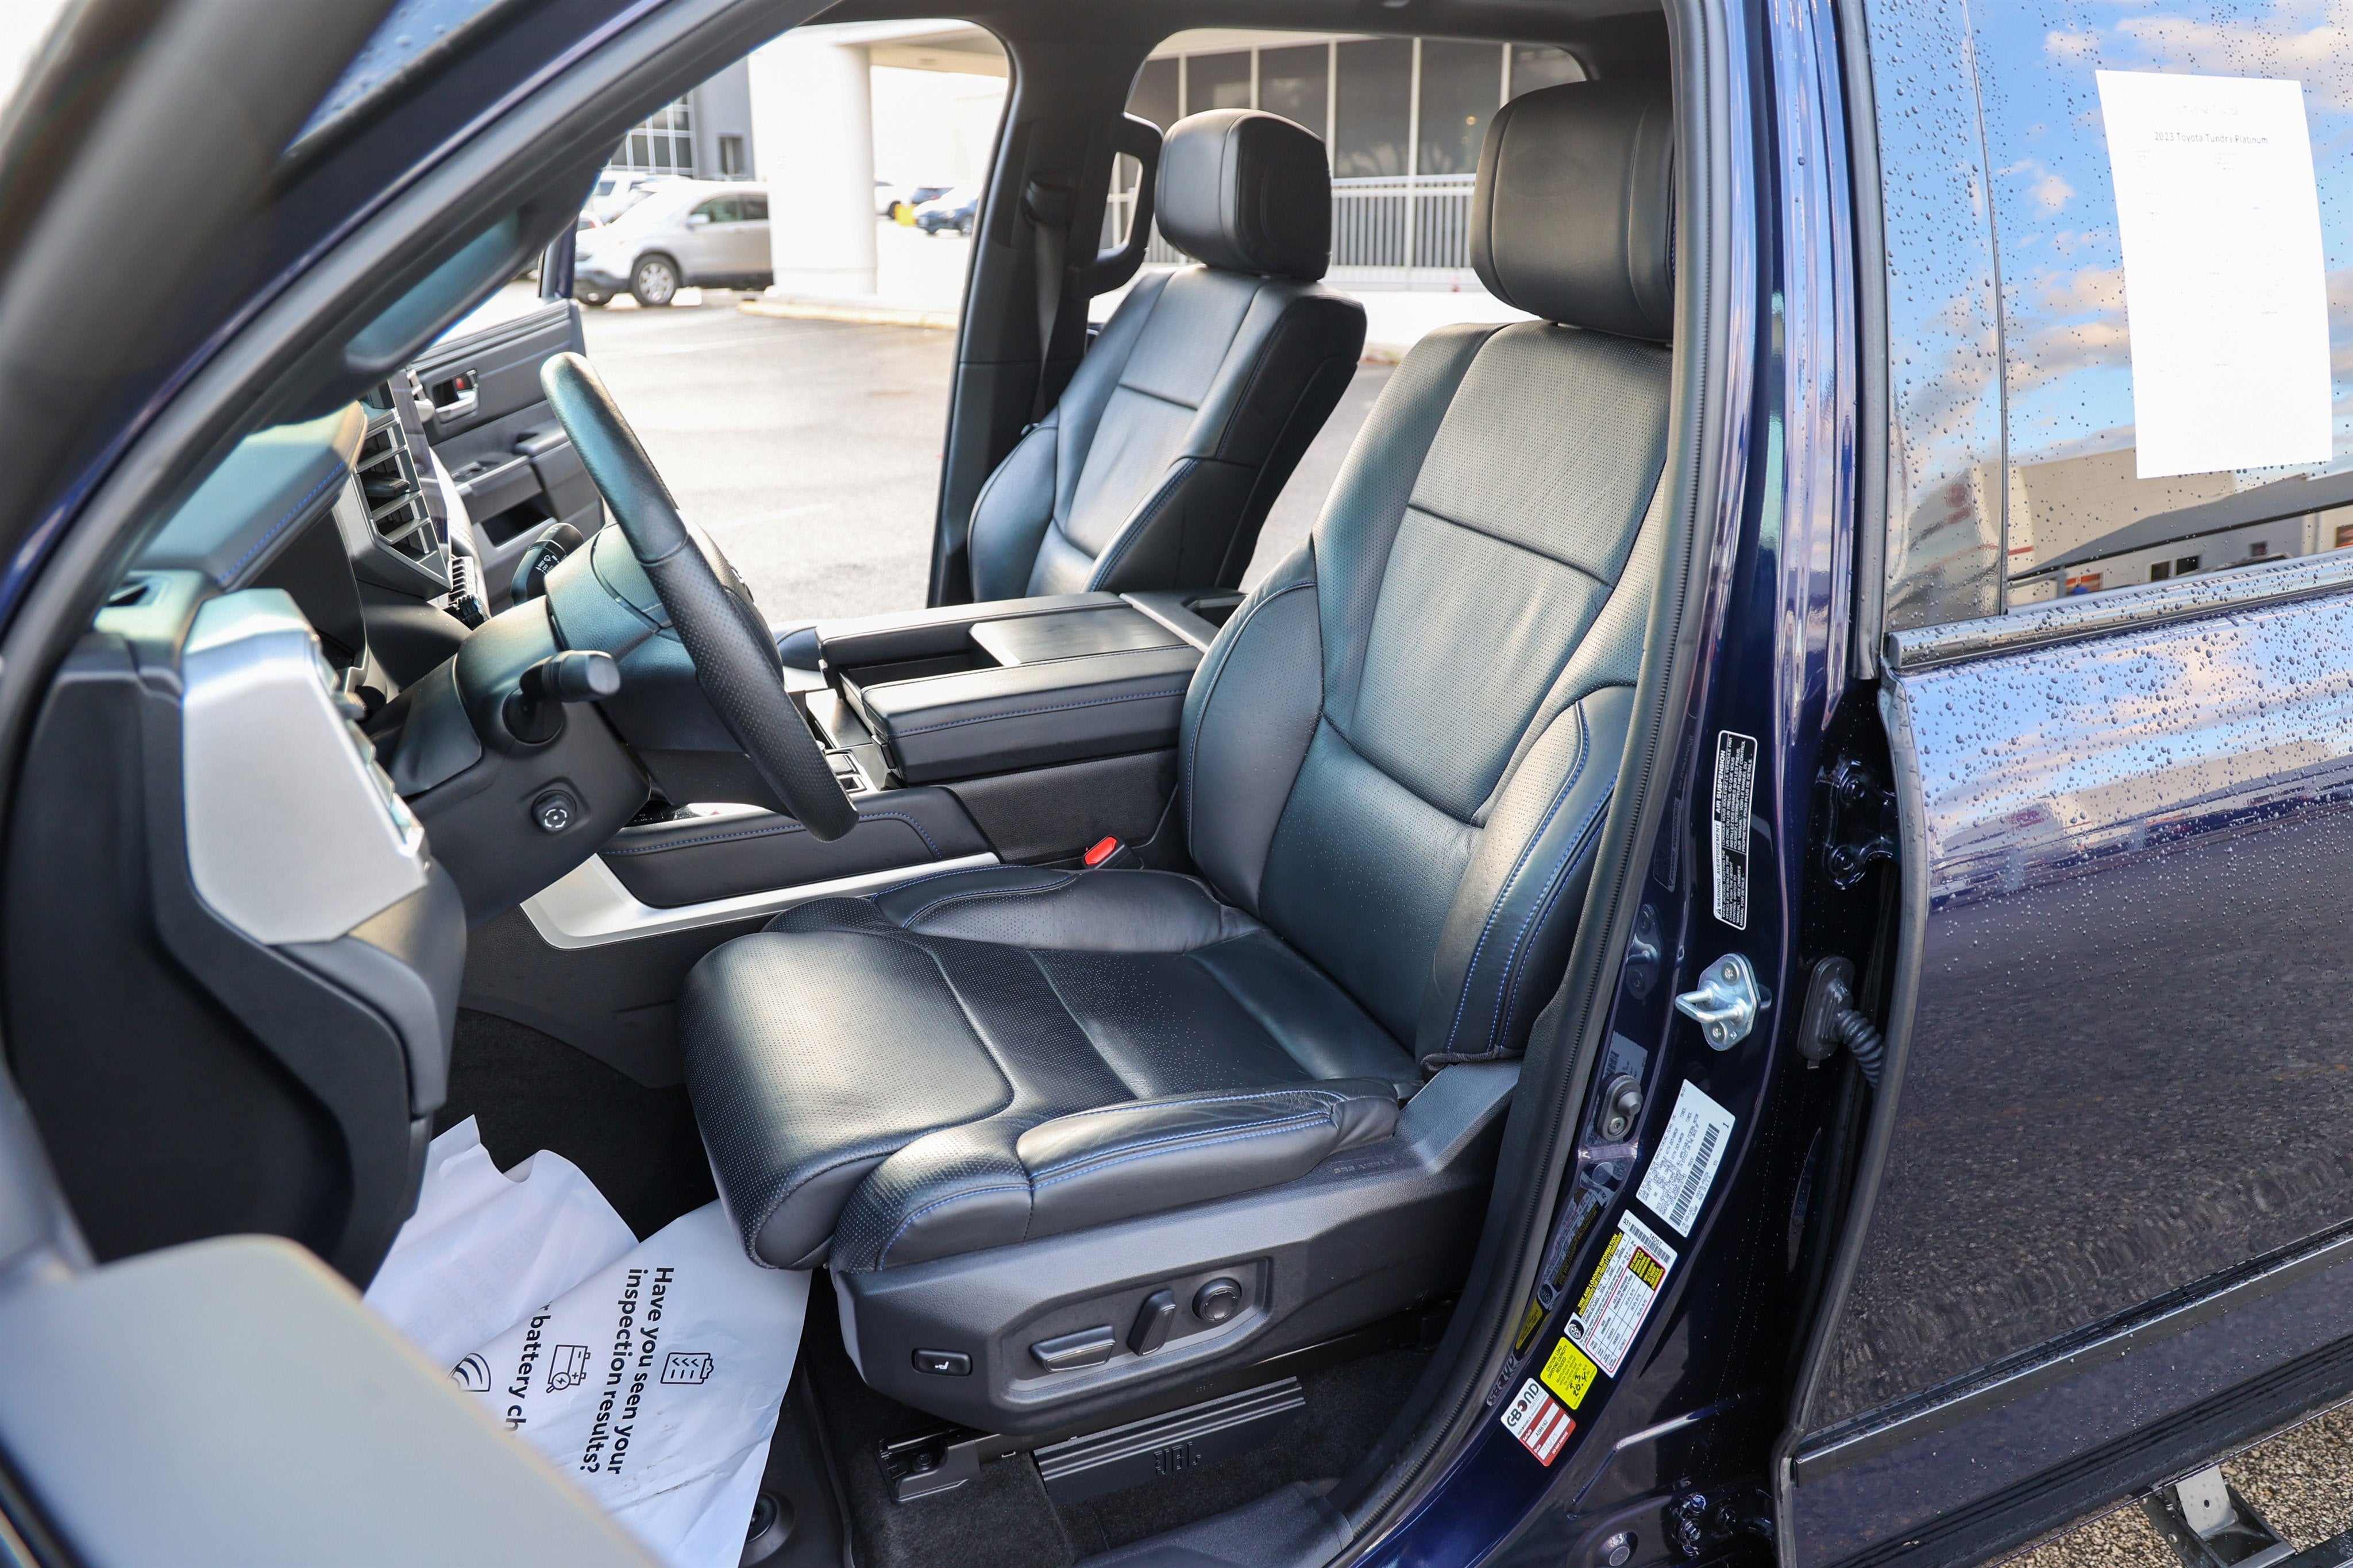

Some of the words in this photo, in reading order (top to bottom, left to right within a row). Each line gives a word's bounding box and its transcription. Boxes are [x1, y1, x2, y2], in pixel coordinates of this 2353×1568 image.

[2155, 132, 2174, 141] 2023
[2176, 132, 2203, 143] Toyota
[2205, 133, 2232, 142] Tundra
[2235, 134, 2269, 144] Platinum
[1716, 750, 1726, 800] SUSPENSION
[1623, 1218, 1631, 1227] 531
[1577, 1296, 1586, 1308] TIRE
[1583, 1286, 1591, 1298] AND
[1588, 1265, 1602, 1287] LOADING
[1598, 1233, 1618, 1266] INFORMATION
[647, 1267, 674, 1322] Have
[607, 1268, 649, 1385] inspection
[640, 1326, 659, 1368] you
[508, 1315, 551, 1399] battery
[1547, 1360, 1559, 1379] CARRYING
[1557, 1344, 1568, 1362] CAPACITY
[1556, 1356, 1567, 1373] REDUCED
[622, 1373, 648, 1420] seen
[580, 1390, 617, 1474] results?
[1533, 1443, 1541, 1453] Date
[1534, 1419, 1548, 1436] A086162
[1558, 1430, 1568, 1444] REMOVE
[607, 1424, 634, 1474] your
[1154, 1441, 1202, 1475] JBL
